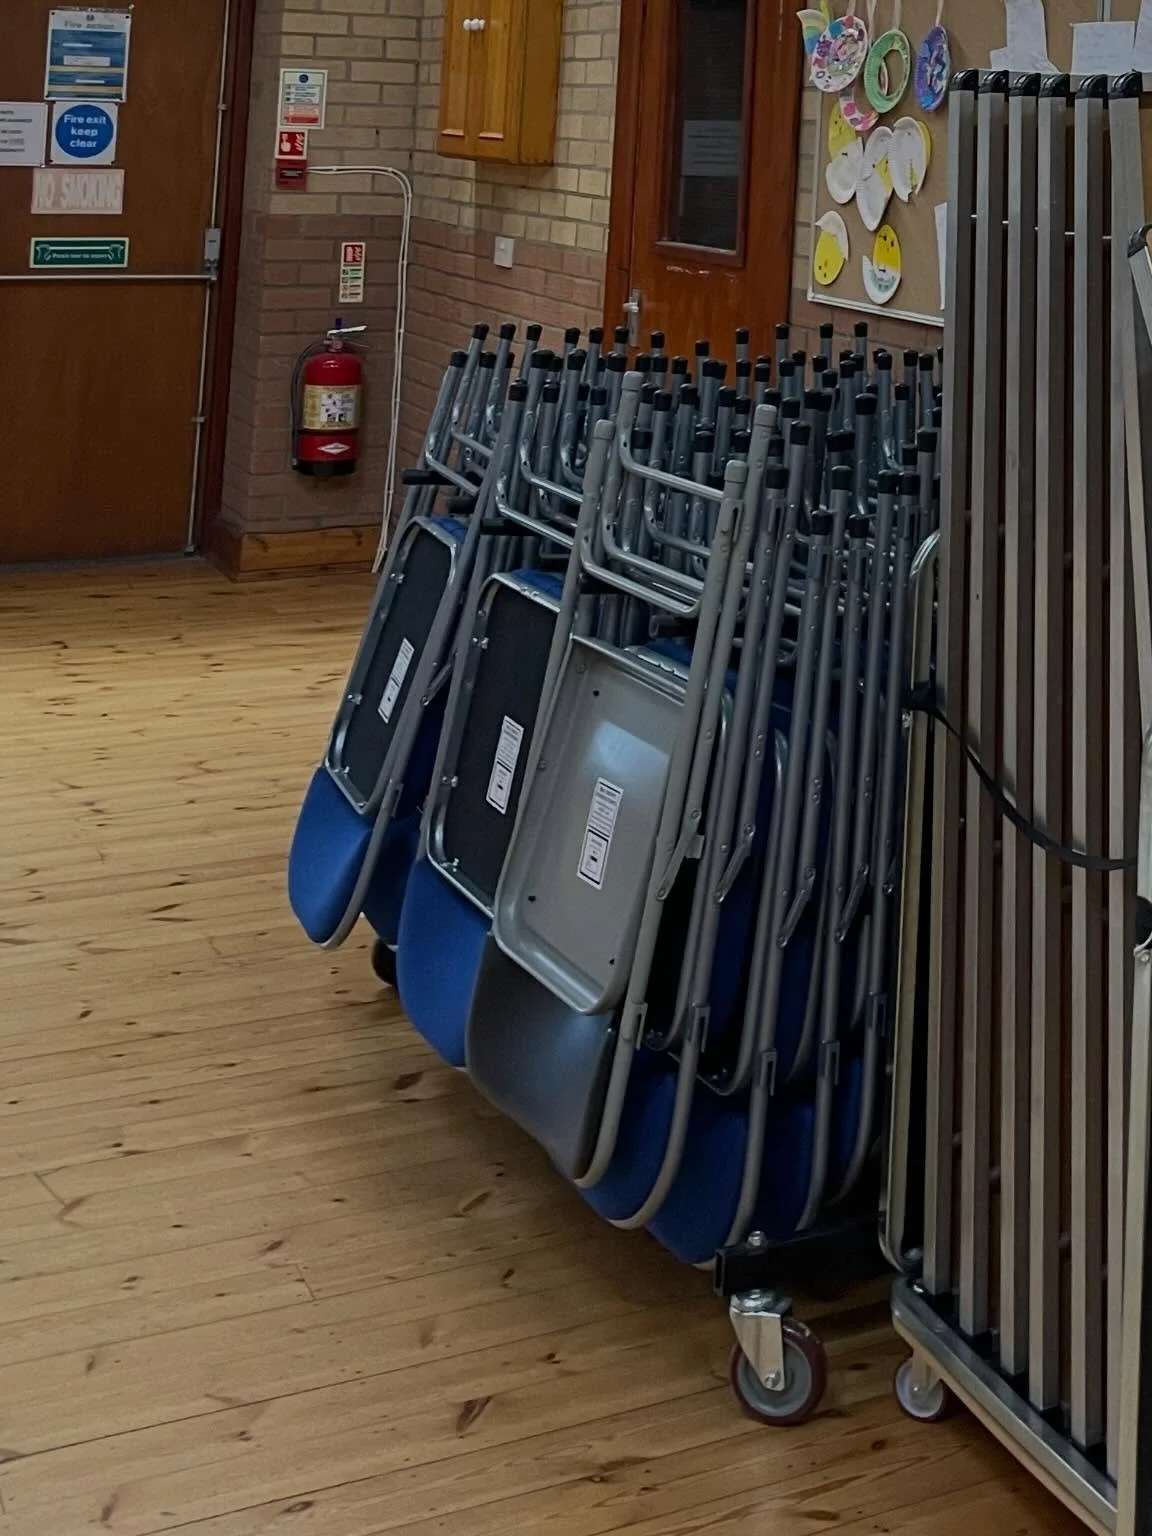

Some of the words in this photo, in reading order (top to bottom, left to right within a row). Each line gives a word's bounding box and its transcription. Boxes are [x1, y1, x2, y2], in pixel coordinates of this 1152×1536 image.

[63, 114, 84, 124] Fire
[86, 114, 107, 125] exit
[70, 126, 98, 137] keep
[69, 138, 97, 148] clear
[35, 172, 55, 209] NO
[60, 172, 122, 209] SMOKING
